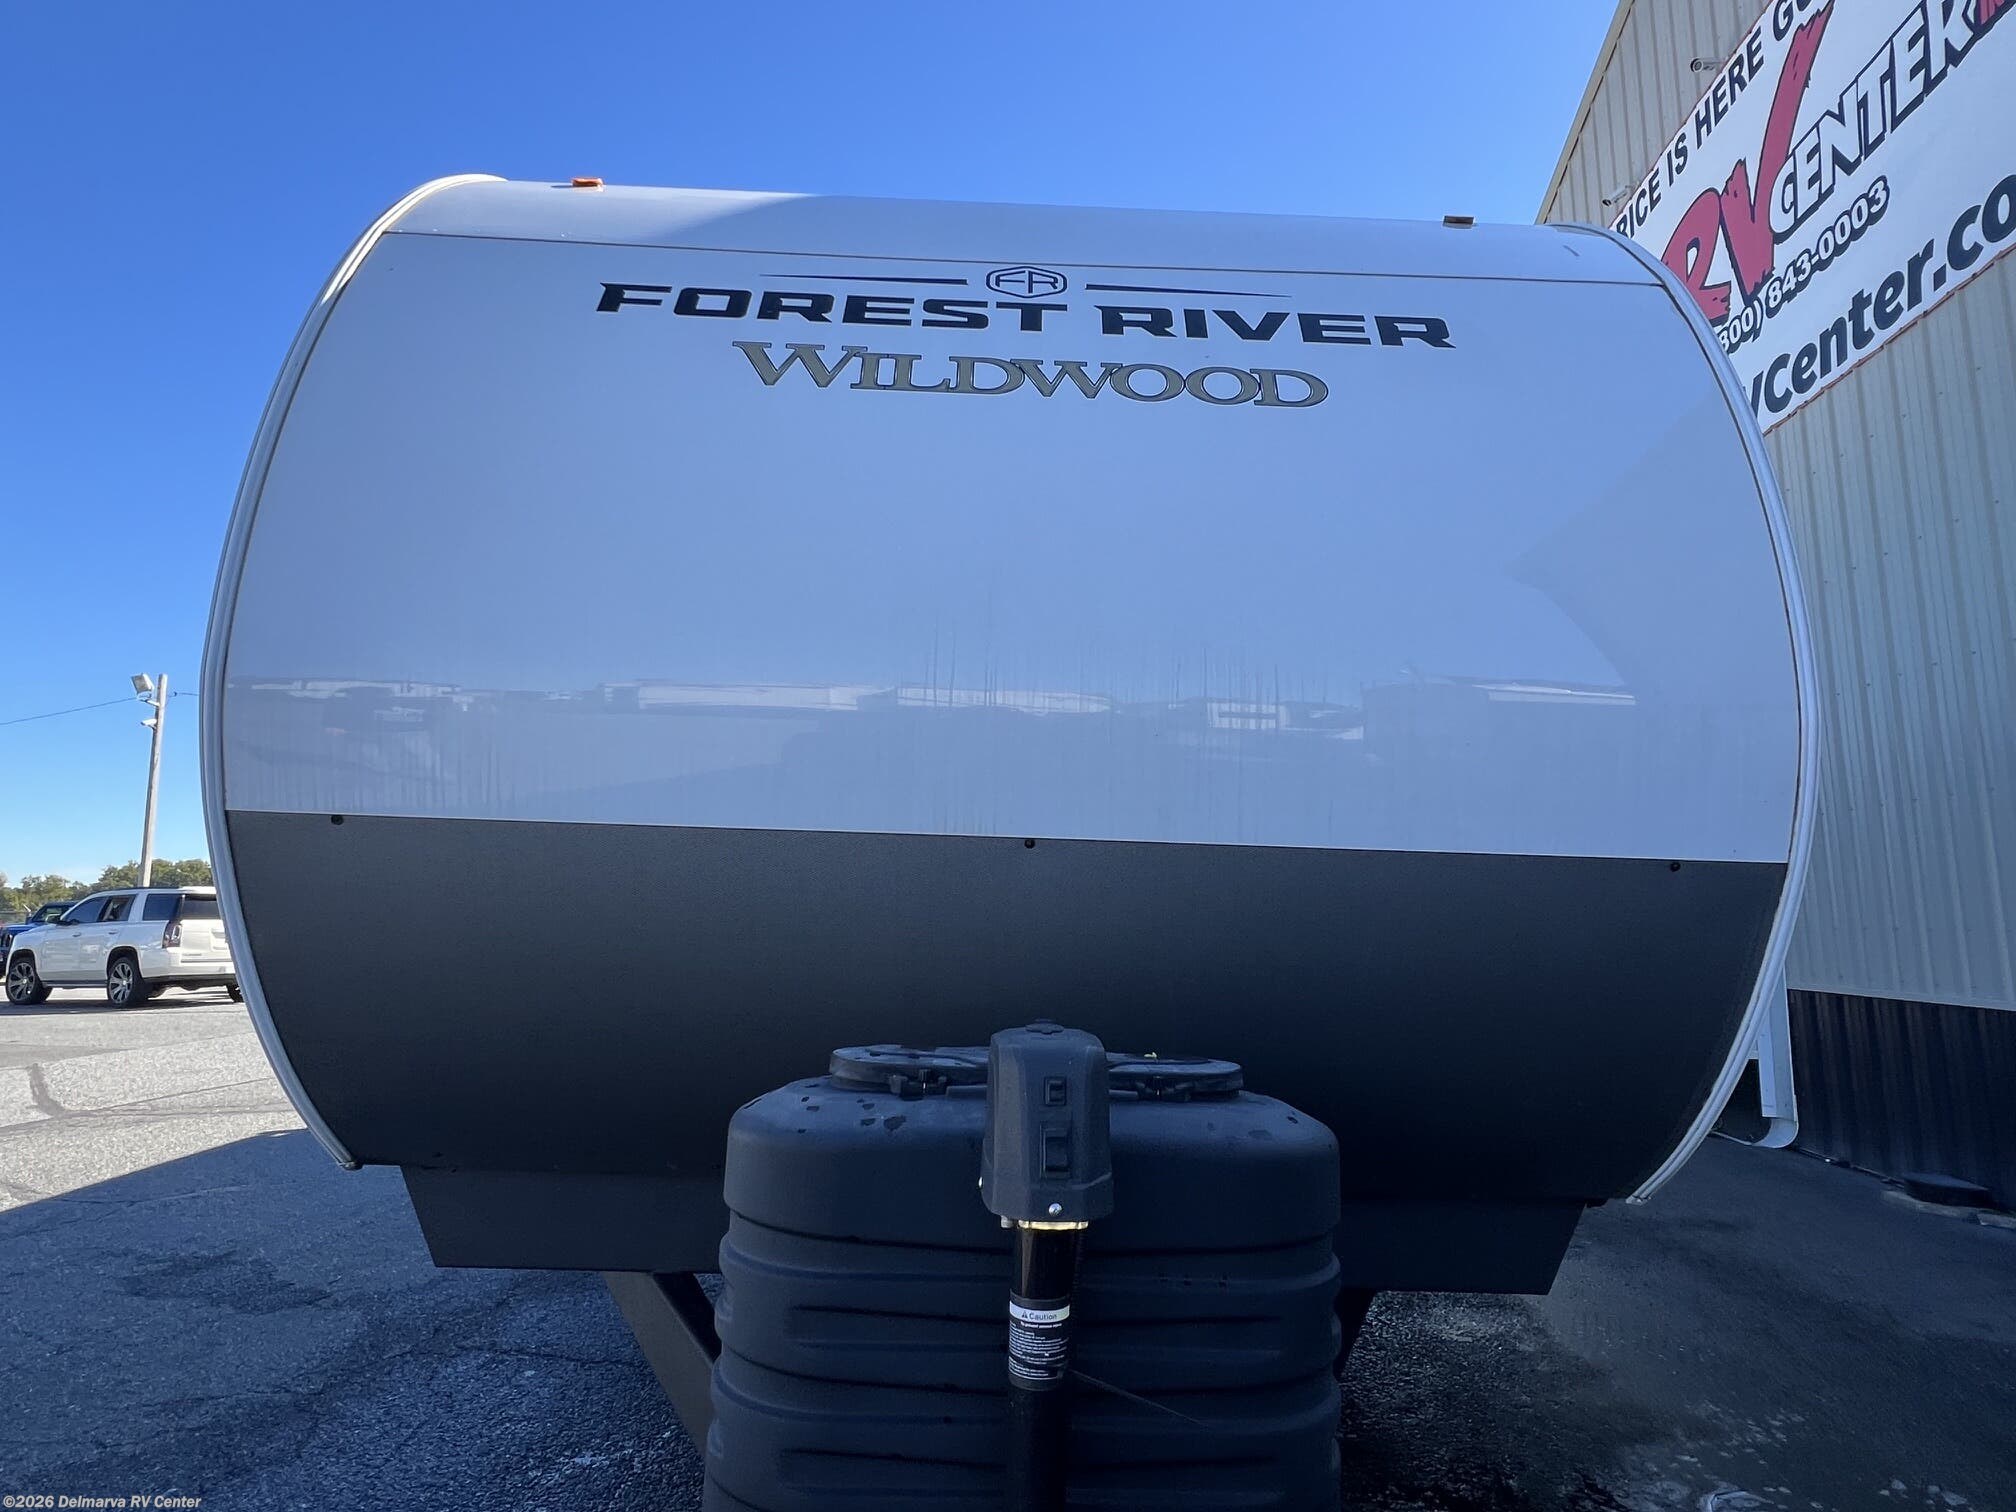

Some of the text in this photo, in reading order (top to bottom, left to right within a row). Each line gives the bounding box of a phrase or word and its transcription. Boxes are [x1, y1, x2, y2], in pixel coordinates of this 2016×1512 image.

[1667, 132, 1688, 187] IS
[1695, 26, 1764, 150] HERE
[1661, 0, 1835, 328] RV
[1766, 175, 1890, 317] 843-0003
[596, 282, 1457, 349] FOREST RIVER
[732, 341, 1329, 407] WILDWOOD
[1029, 1312, 1058, 1321] Caution
